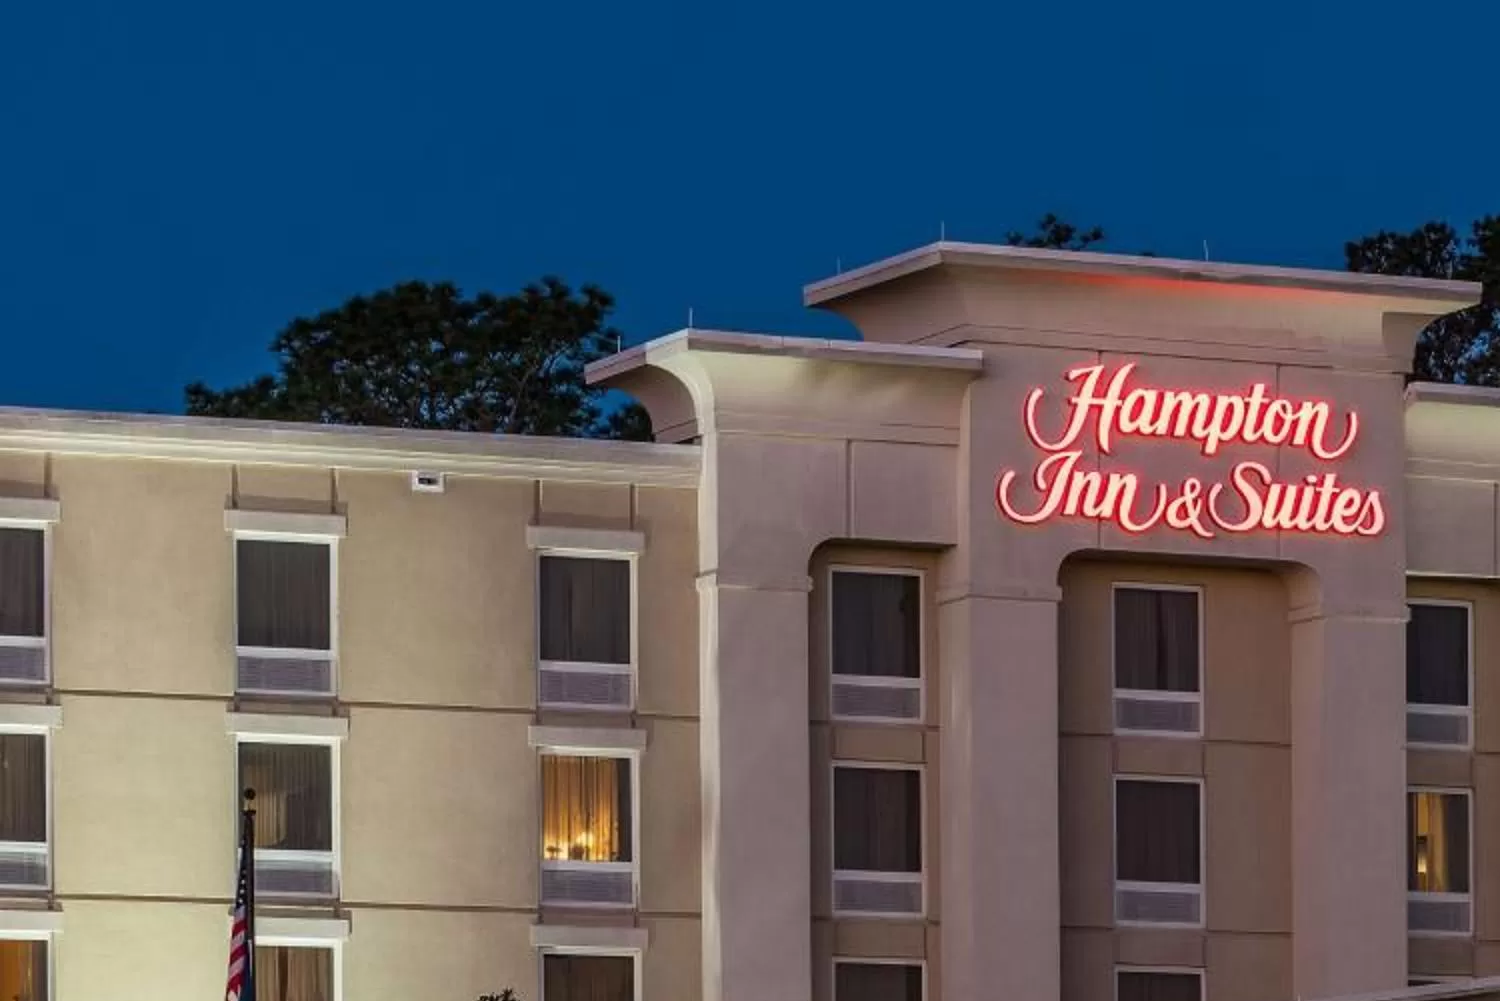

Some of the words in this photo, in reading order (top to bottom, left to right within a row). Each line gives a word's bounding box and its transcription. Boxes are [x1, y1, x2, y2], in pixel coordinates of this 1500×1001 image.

[1025, 363, 1358, 460] Hampton
[1000, 450, 1166, 533] Inn
[1166, 477, 1215, 538] &
[1208, 461, 1386, 536] Suites
